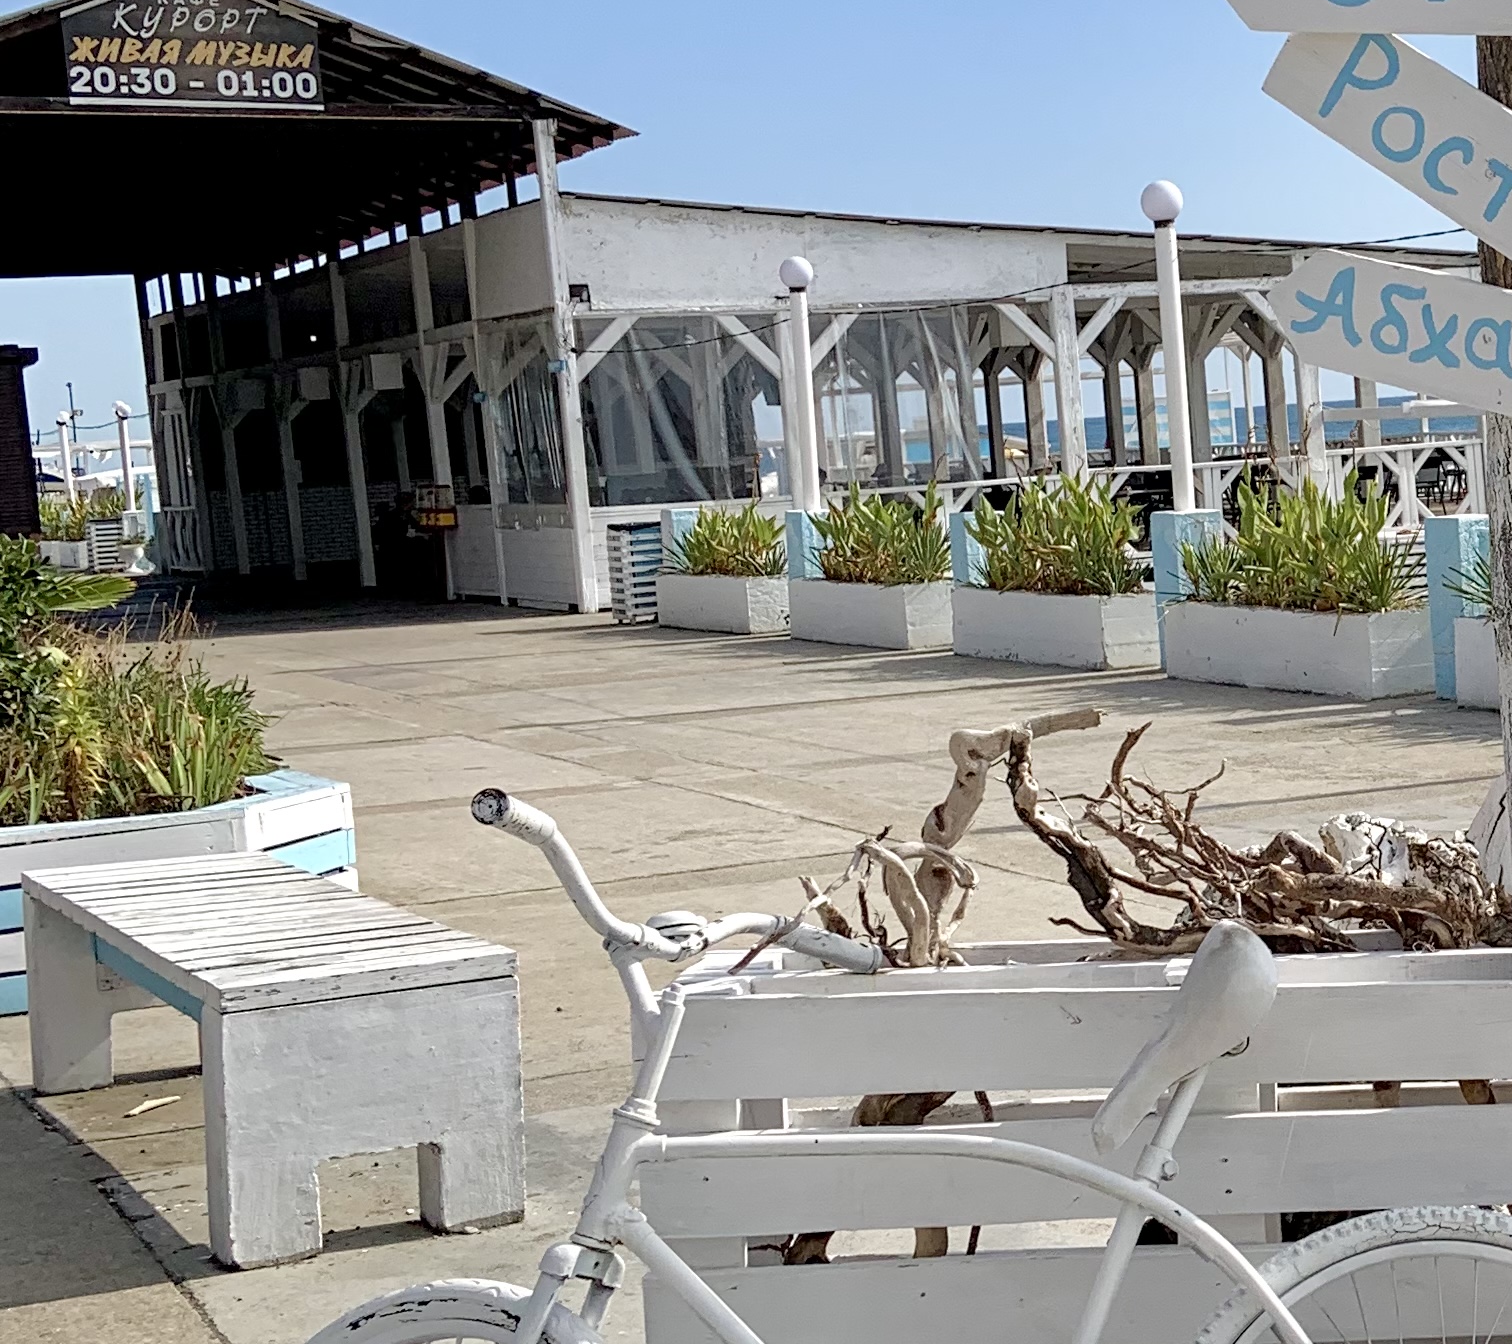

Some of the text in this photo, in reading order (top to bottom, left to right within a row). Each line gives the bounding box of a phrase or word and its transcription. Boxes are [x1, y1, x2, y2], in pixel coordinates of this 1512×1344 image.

[68, 35, 316, 69] ЖИВАЯ МУЗЫКА
[69, 65, 177, 95] 20:30
[216, 68, 318, 99] 01:00
